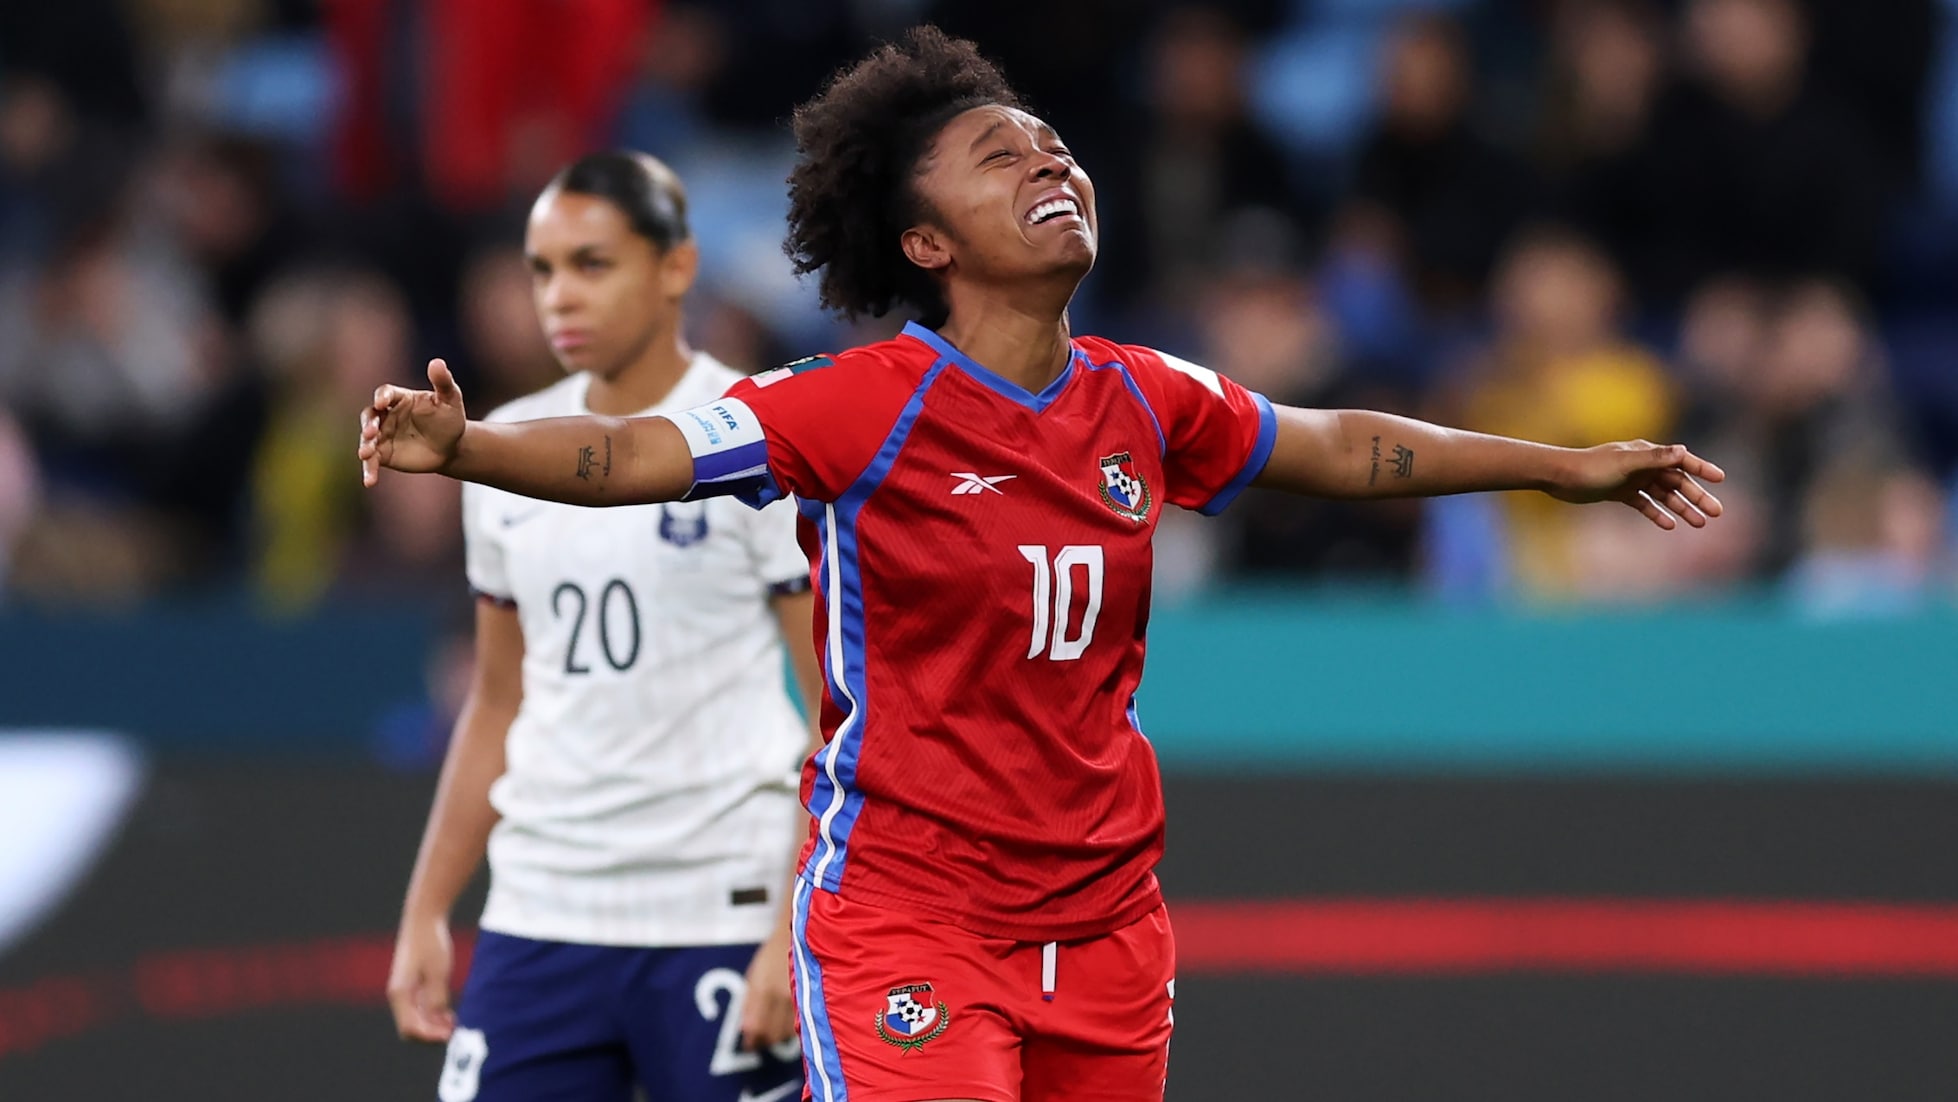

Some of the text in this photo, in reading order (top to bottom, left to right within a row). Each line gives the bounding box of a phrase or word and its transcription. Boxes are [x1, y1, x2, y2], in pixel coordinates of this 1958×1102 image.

[712, 405, 738, 431] FIFA
[553, 579, 640, 674] 20
[1017, 545, 1104, 660] 10
[694, 968, 800, 1076] 2
